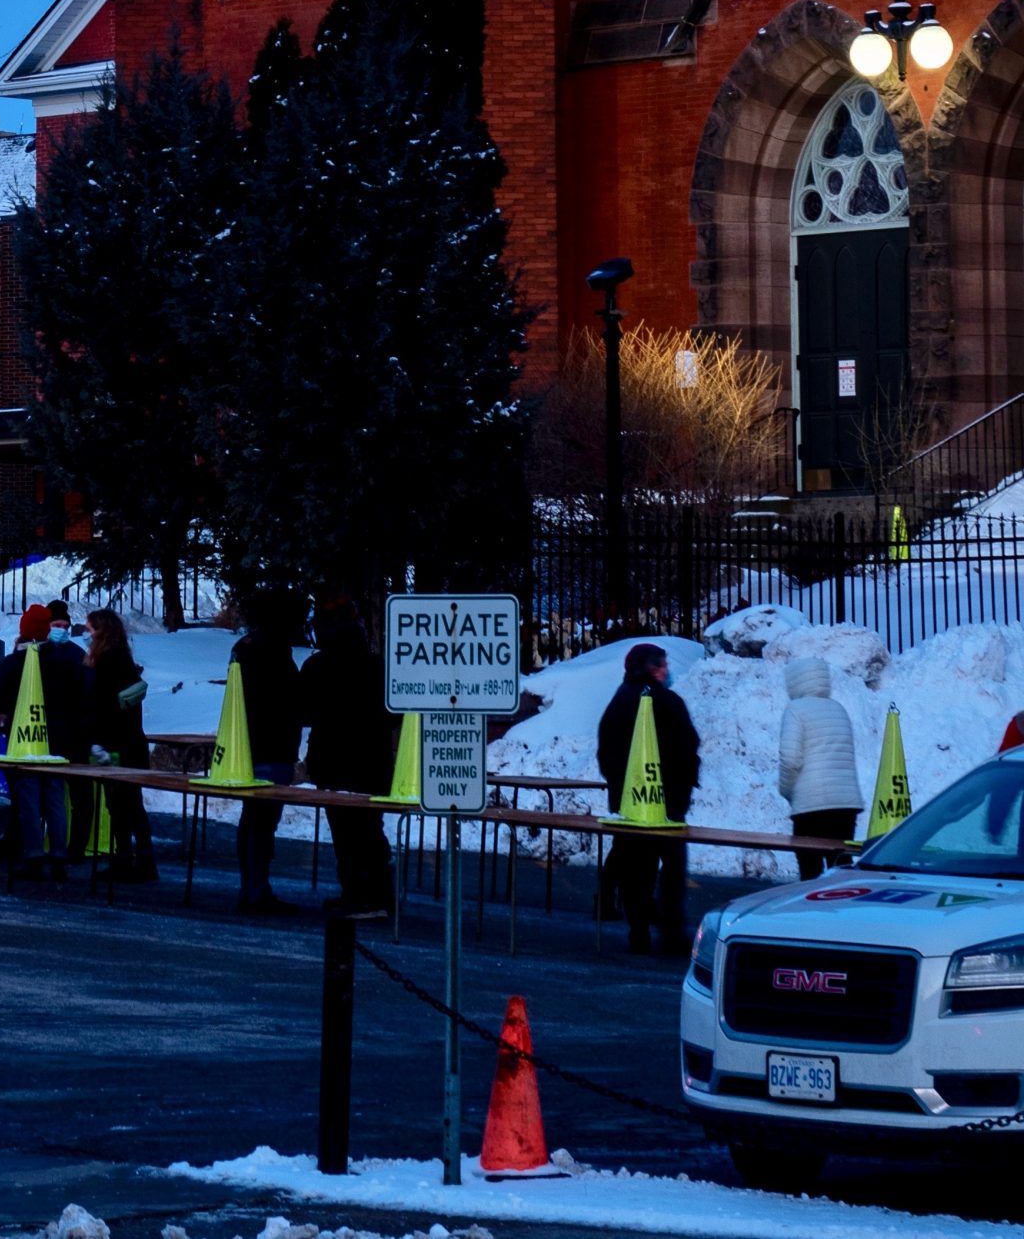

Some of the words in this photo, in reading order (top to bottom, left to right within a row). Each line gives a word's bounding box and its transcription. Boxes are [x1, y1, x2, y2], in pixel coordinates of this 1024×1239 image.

[398, 613, 509, 637] PRIVATE
[395, 642, 511, 666] PARKING
[483, 679, 514, 696] #88-170
[430, 713, 475, 725] PRIVATE
[424, 729, 480, 743] PROPERTY
[432, 747, 473, 761] PERMIT
[429, 765, 477, 778] PARKING
[438, 782, 467, 796] ONLY
[772, 967, 848, 995] GMC
